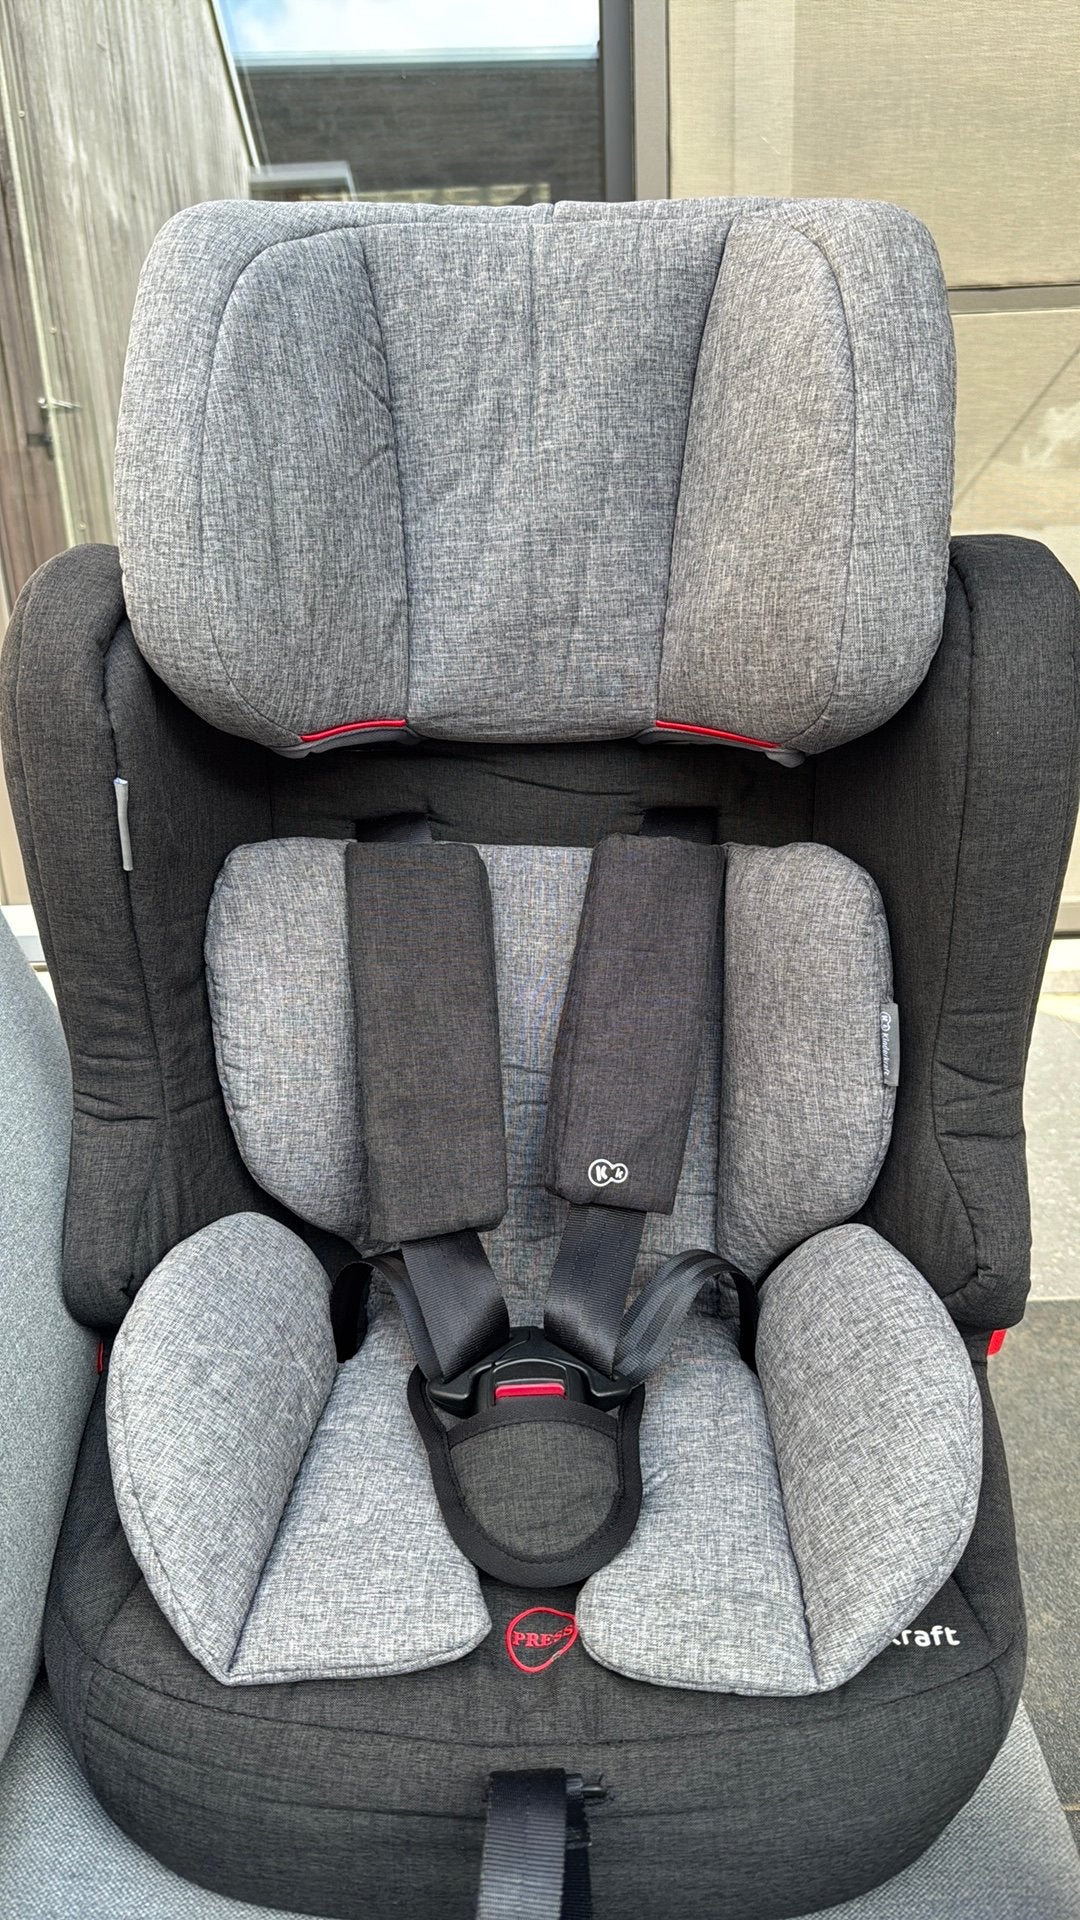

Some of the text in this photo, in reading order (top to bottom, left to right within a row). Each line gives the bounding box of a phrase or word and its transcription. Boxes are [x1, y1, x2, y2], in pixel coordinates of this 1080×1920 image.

[882, 1032, 890, 1076] Kinderkraft
[512, 1624, 573, 1648] PRESS
[892, 1625, 960, 1647] raft
